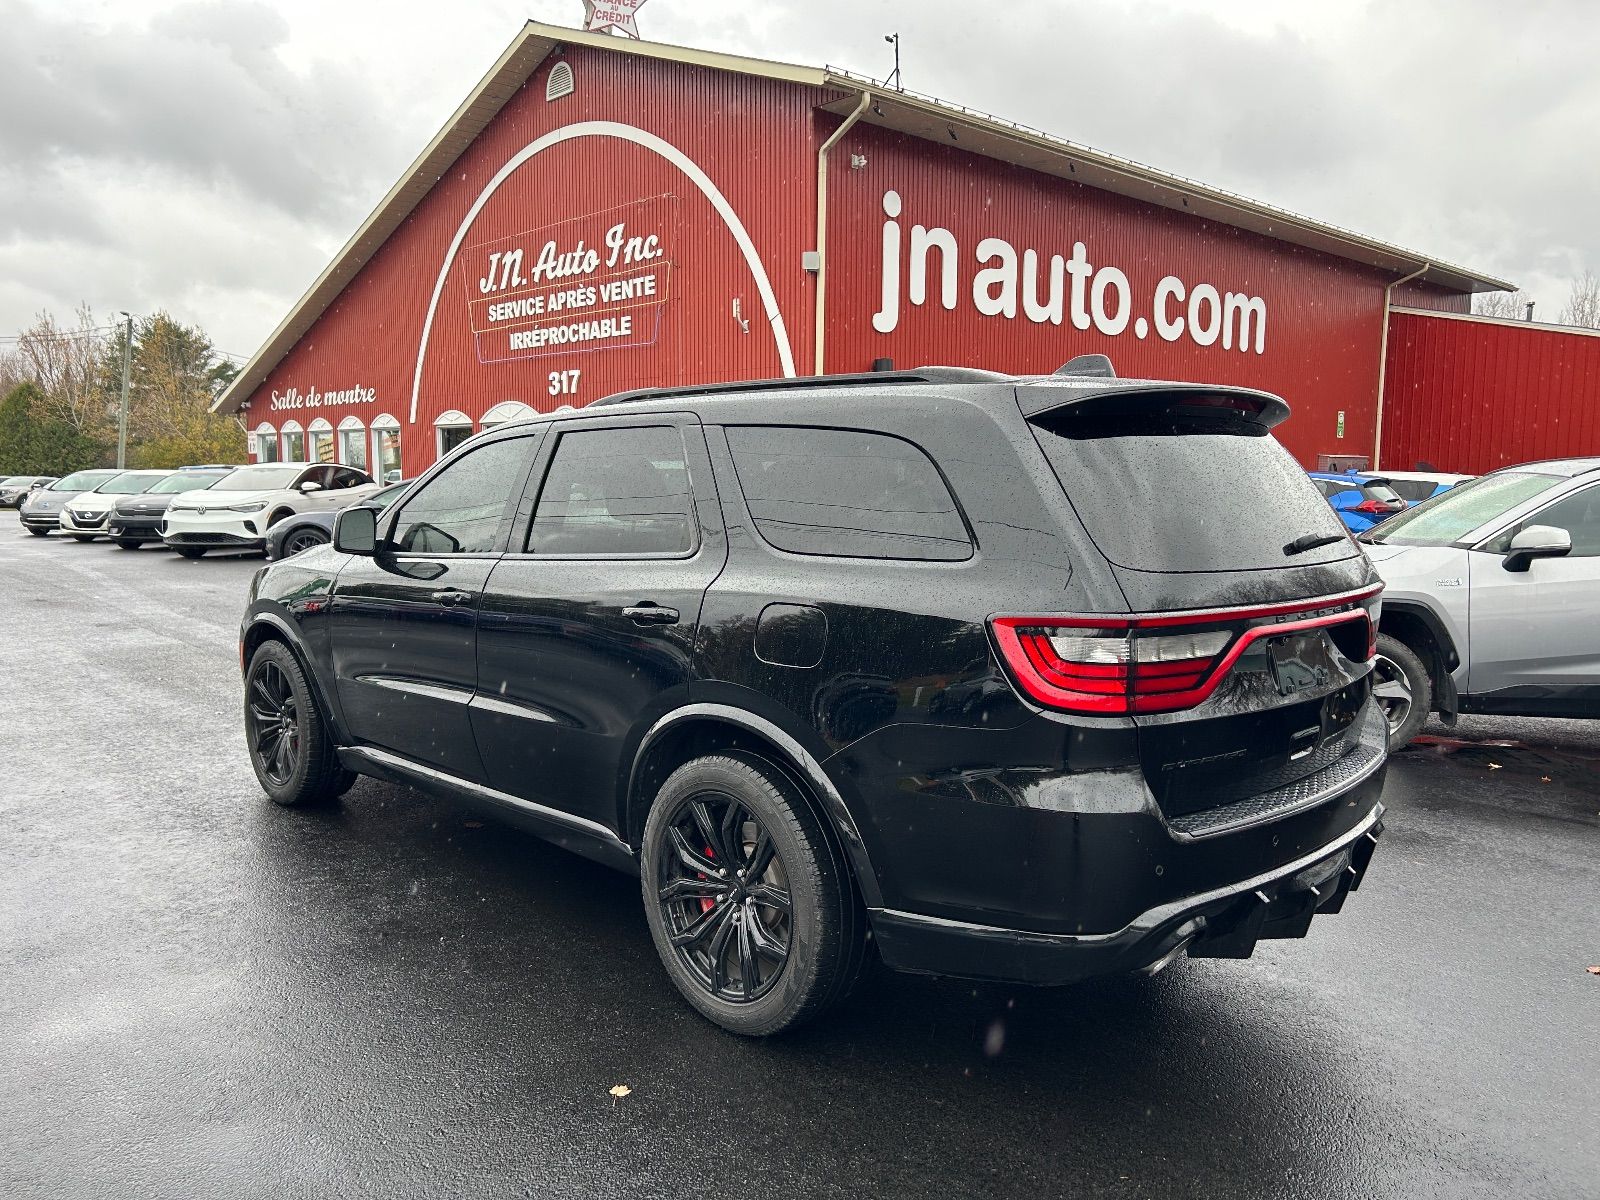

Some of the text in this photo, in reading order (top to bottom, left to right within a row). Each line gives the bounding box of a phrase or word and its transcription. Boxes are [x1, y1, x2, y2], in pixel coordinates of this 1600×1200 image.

[595, 10, 631, 24] CRÉDIT
[479, 223, 664, 294] J.N. Auto Inc.
[488, 275, 657, 322] SERVICE APRÈS VENTE
[510, 315, 632, 351] IRRÉPROCHABLE
[270, 383, 377, 411] Salle de montre
[548, 369, 581, 396] 317
